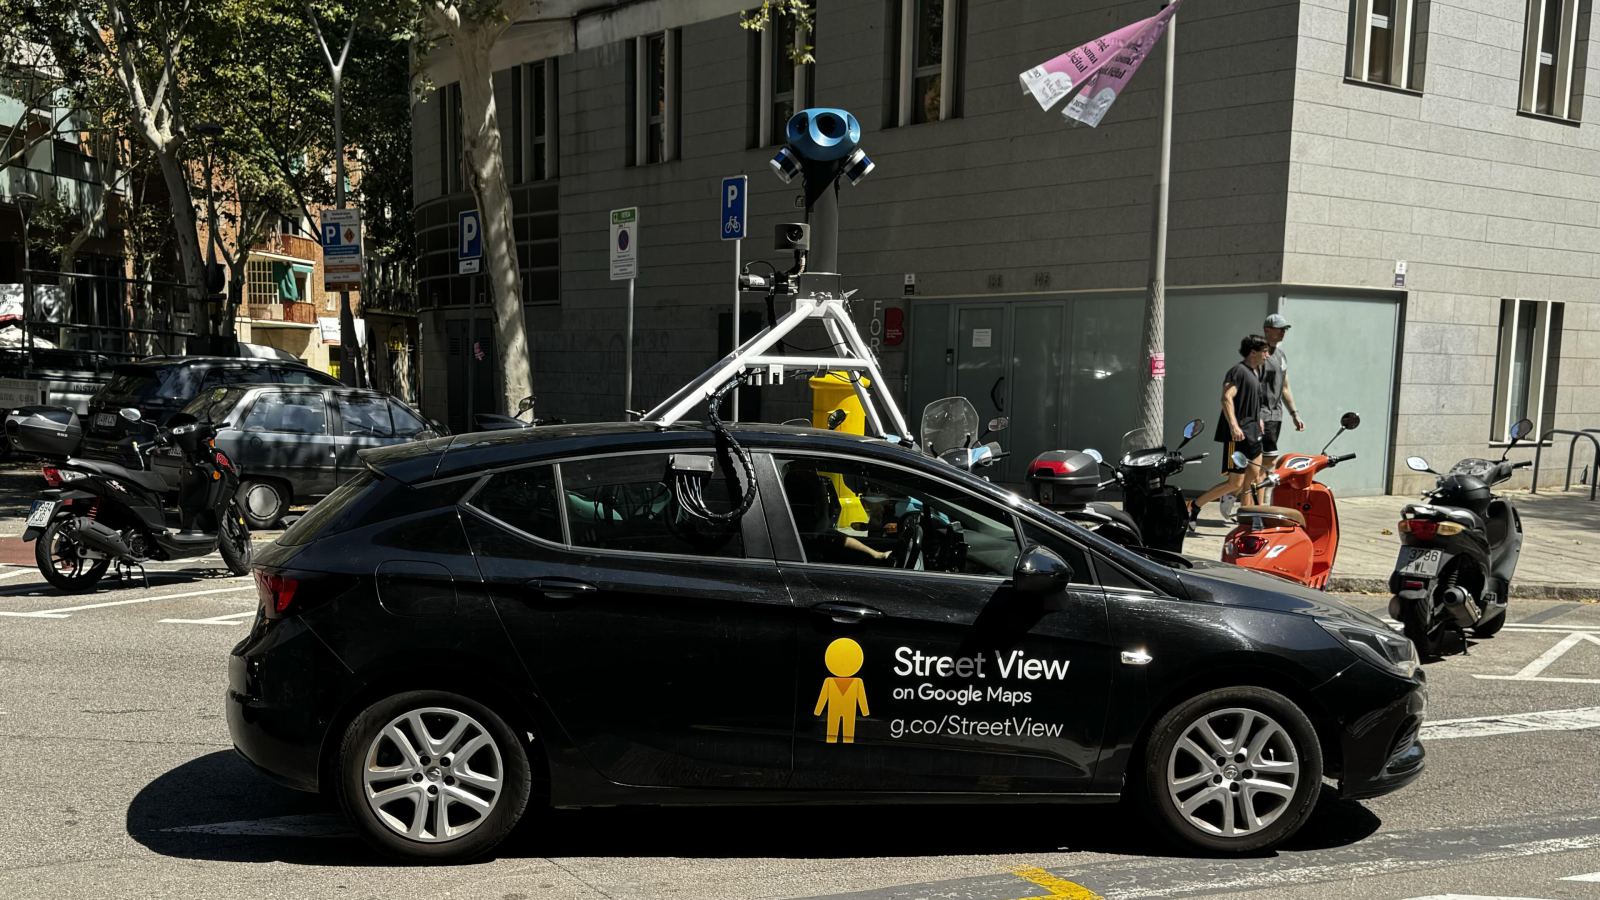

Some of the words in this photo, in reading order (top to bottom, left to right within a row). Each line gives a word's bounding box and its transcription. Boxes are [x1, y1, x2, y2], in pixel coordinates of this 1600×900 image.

[726, 185, 738, 208] P
[326, 226, 336, 243] P
[463, 216, 477, 253] P
[870, 300, 882, 355] FOR
[1409, 549, 1439, 562] 3796
[893, 646, 986, 678] Street
[995, 650, 1071, 681] View
[893, 687, 914, 700] on
[918, 683, 983, 706] Google
[986, 686, 1032, 707] Maps
[890, 715, 1064, 739] g.co/StreetView
